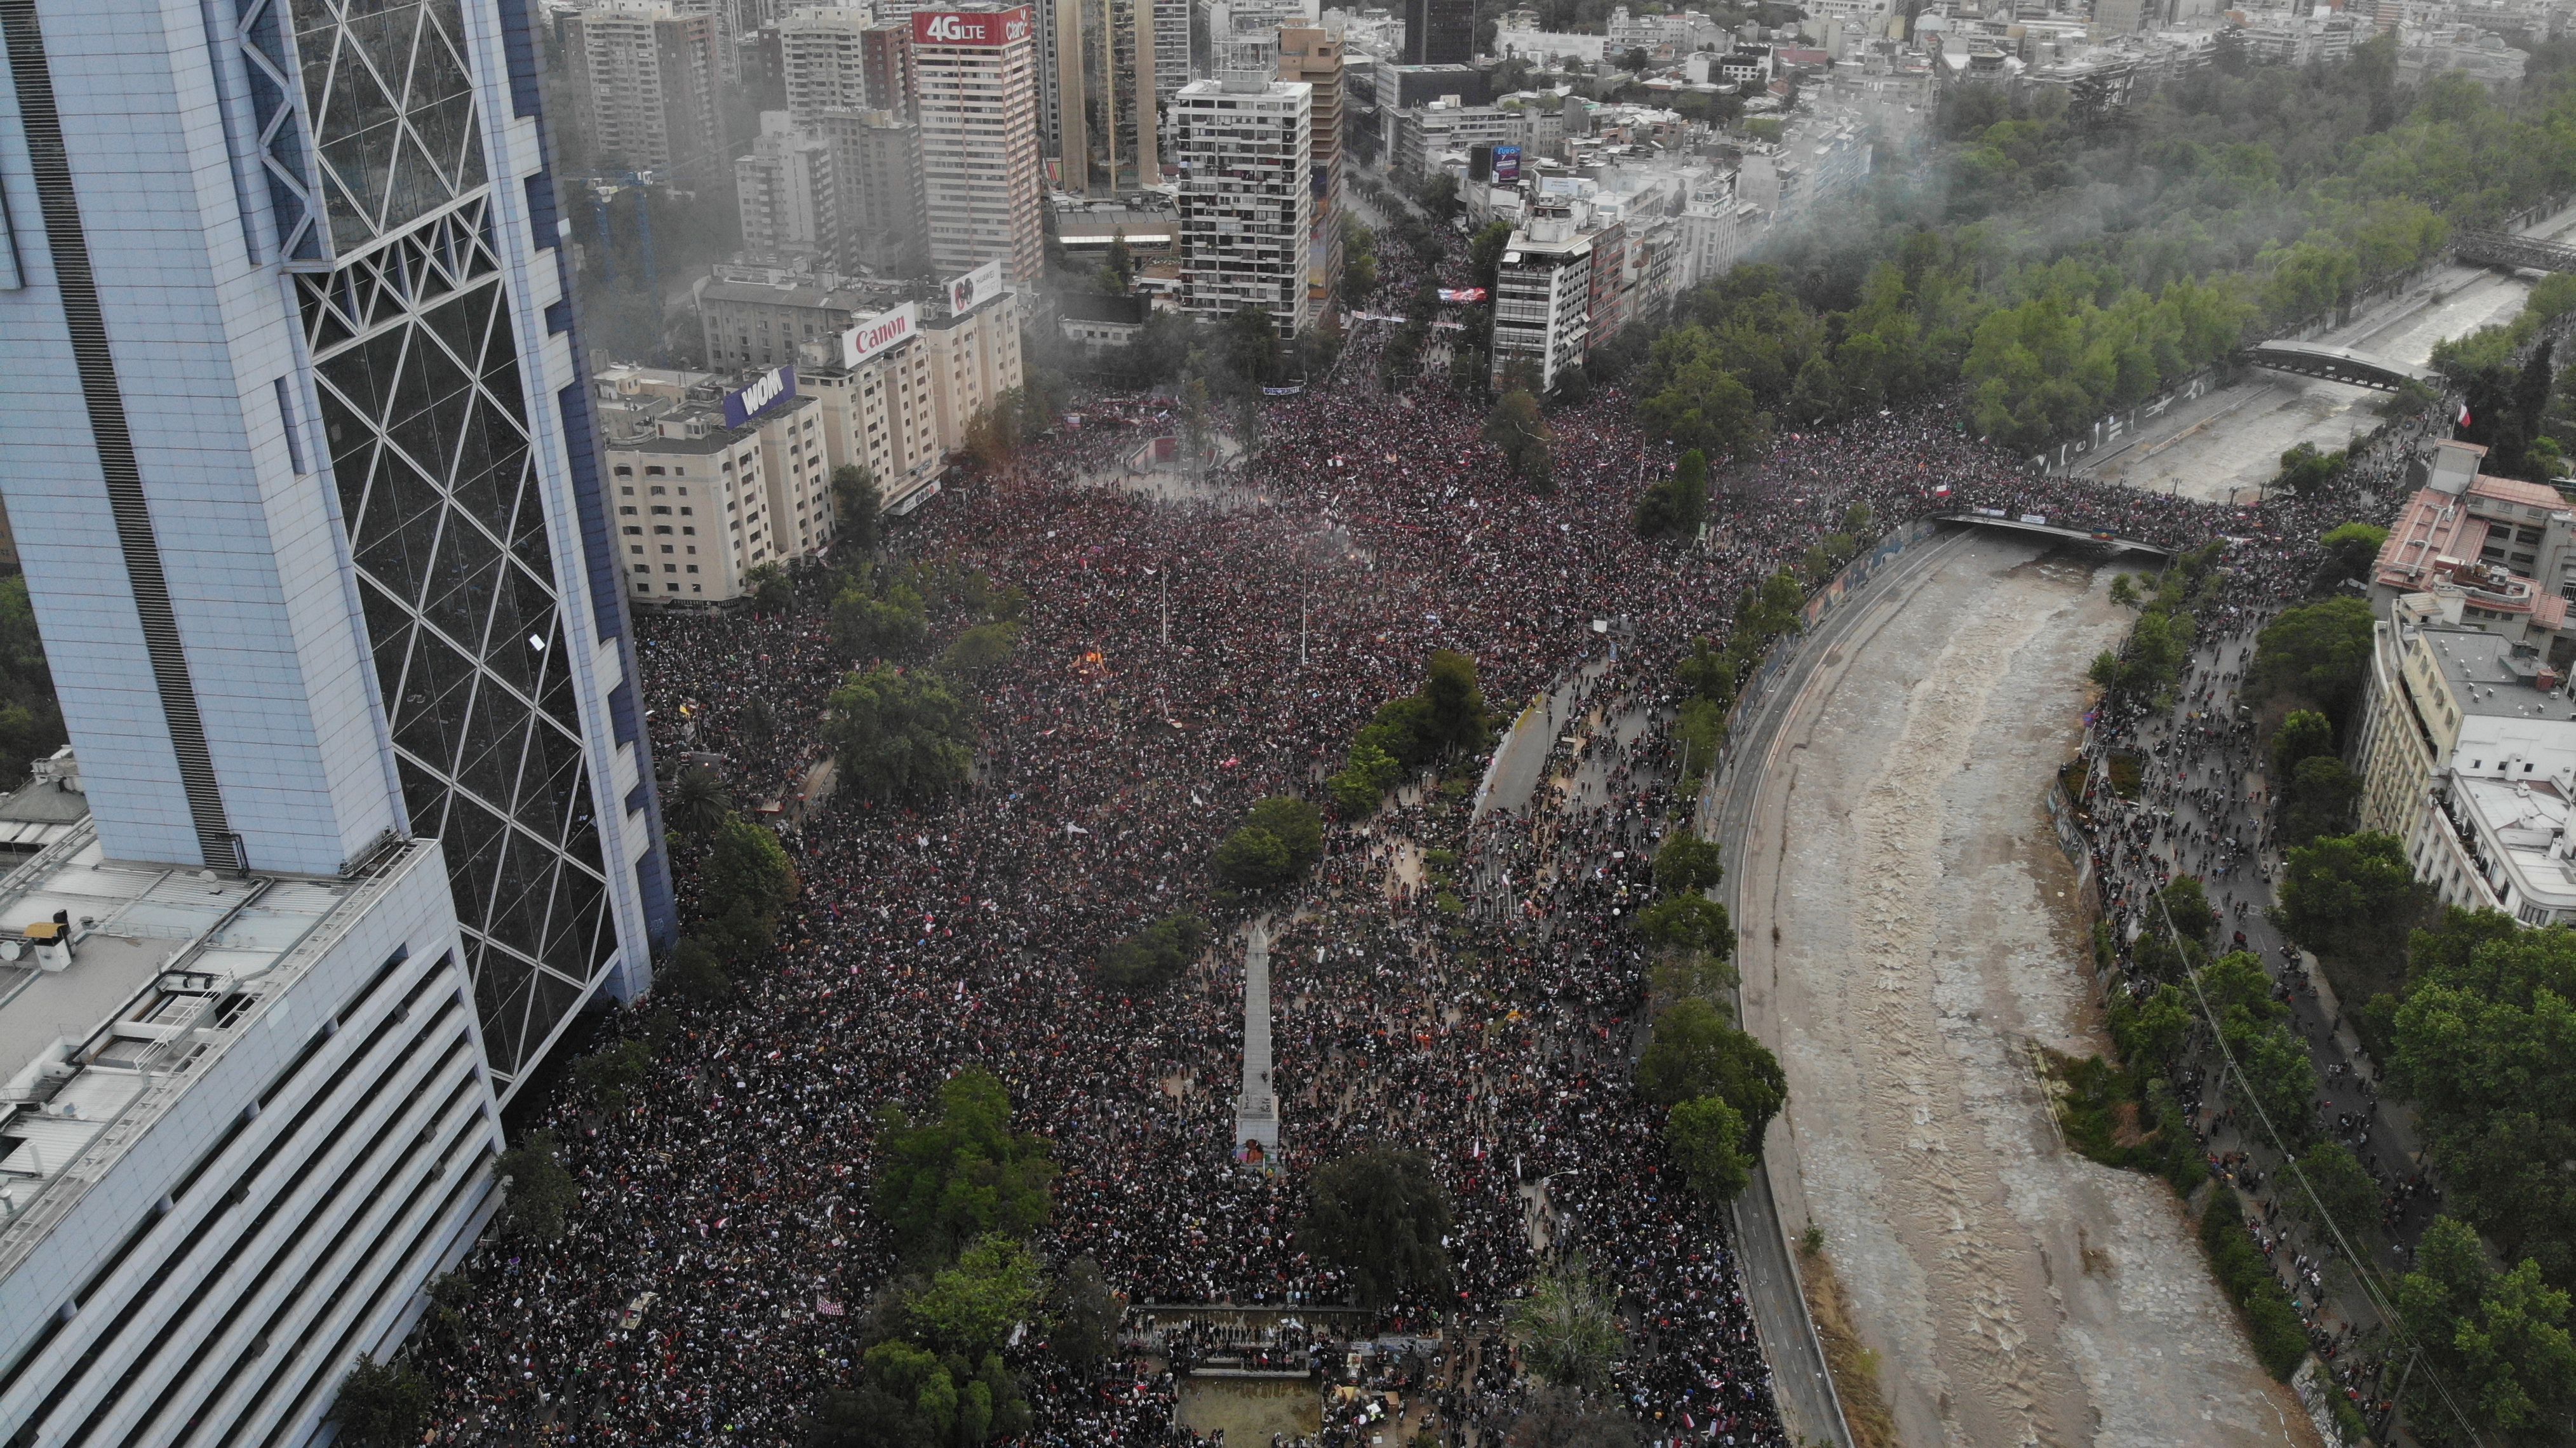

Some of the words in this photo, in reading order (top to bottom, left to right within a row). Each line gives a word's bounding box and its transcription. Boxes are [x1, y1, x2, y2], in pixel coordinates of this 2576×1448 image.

[927, 16, 961, 41] 4G
[962, 25, 985, 39] LTE
[1006, 20, 1026, 41] Claro
[976, 270, 995, 285] HUAWEI
[855, 315, 906, 354] Canon
[741, 367, 784, 416] WOM
